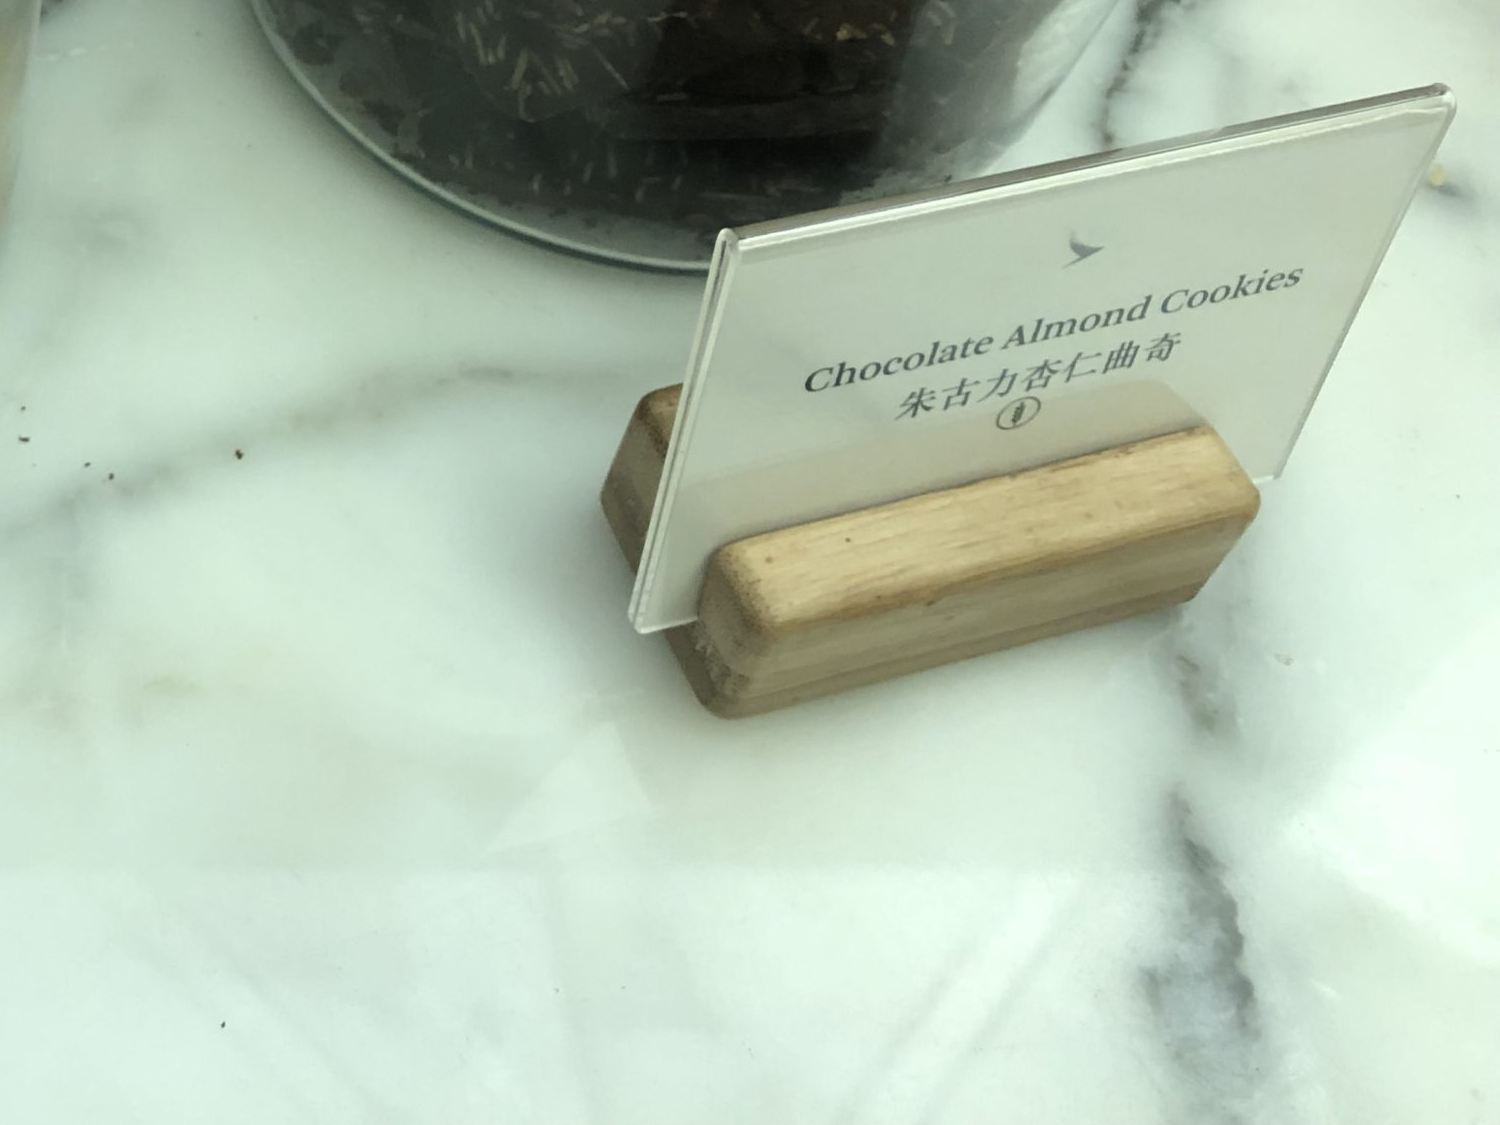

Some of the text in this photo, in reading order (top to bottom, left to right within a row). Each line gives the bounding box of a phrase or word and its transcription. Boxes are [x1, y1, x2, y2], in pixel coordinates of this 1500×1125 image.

[803, 267, 1305, 393] Chocolate Almond Cookies
[894, 331, 1184, 421] 朱古力杏仁曲奇
